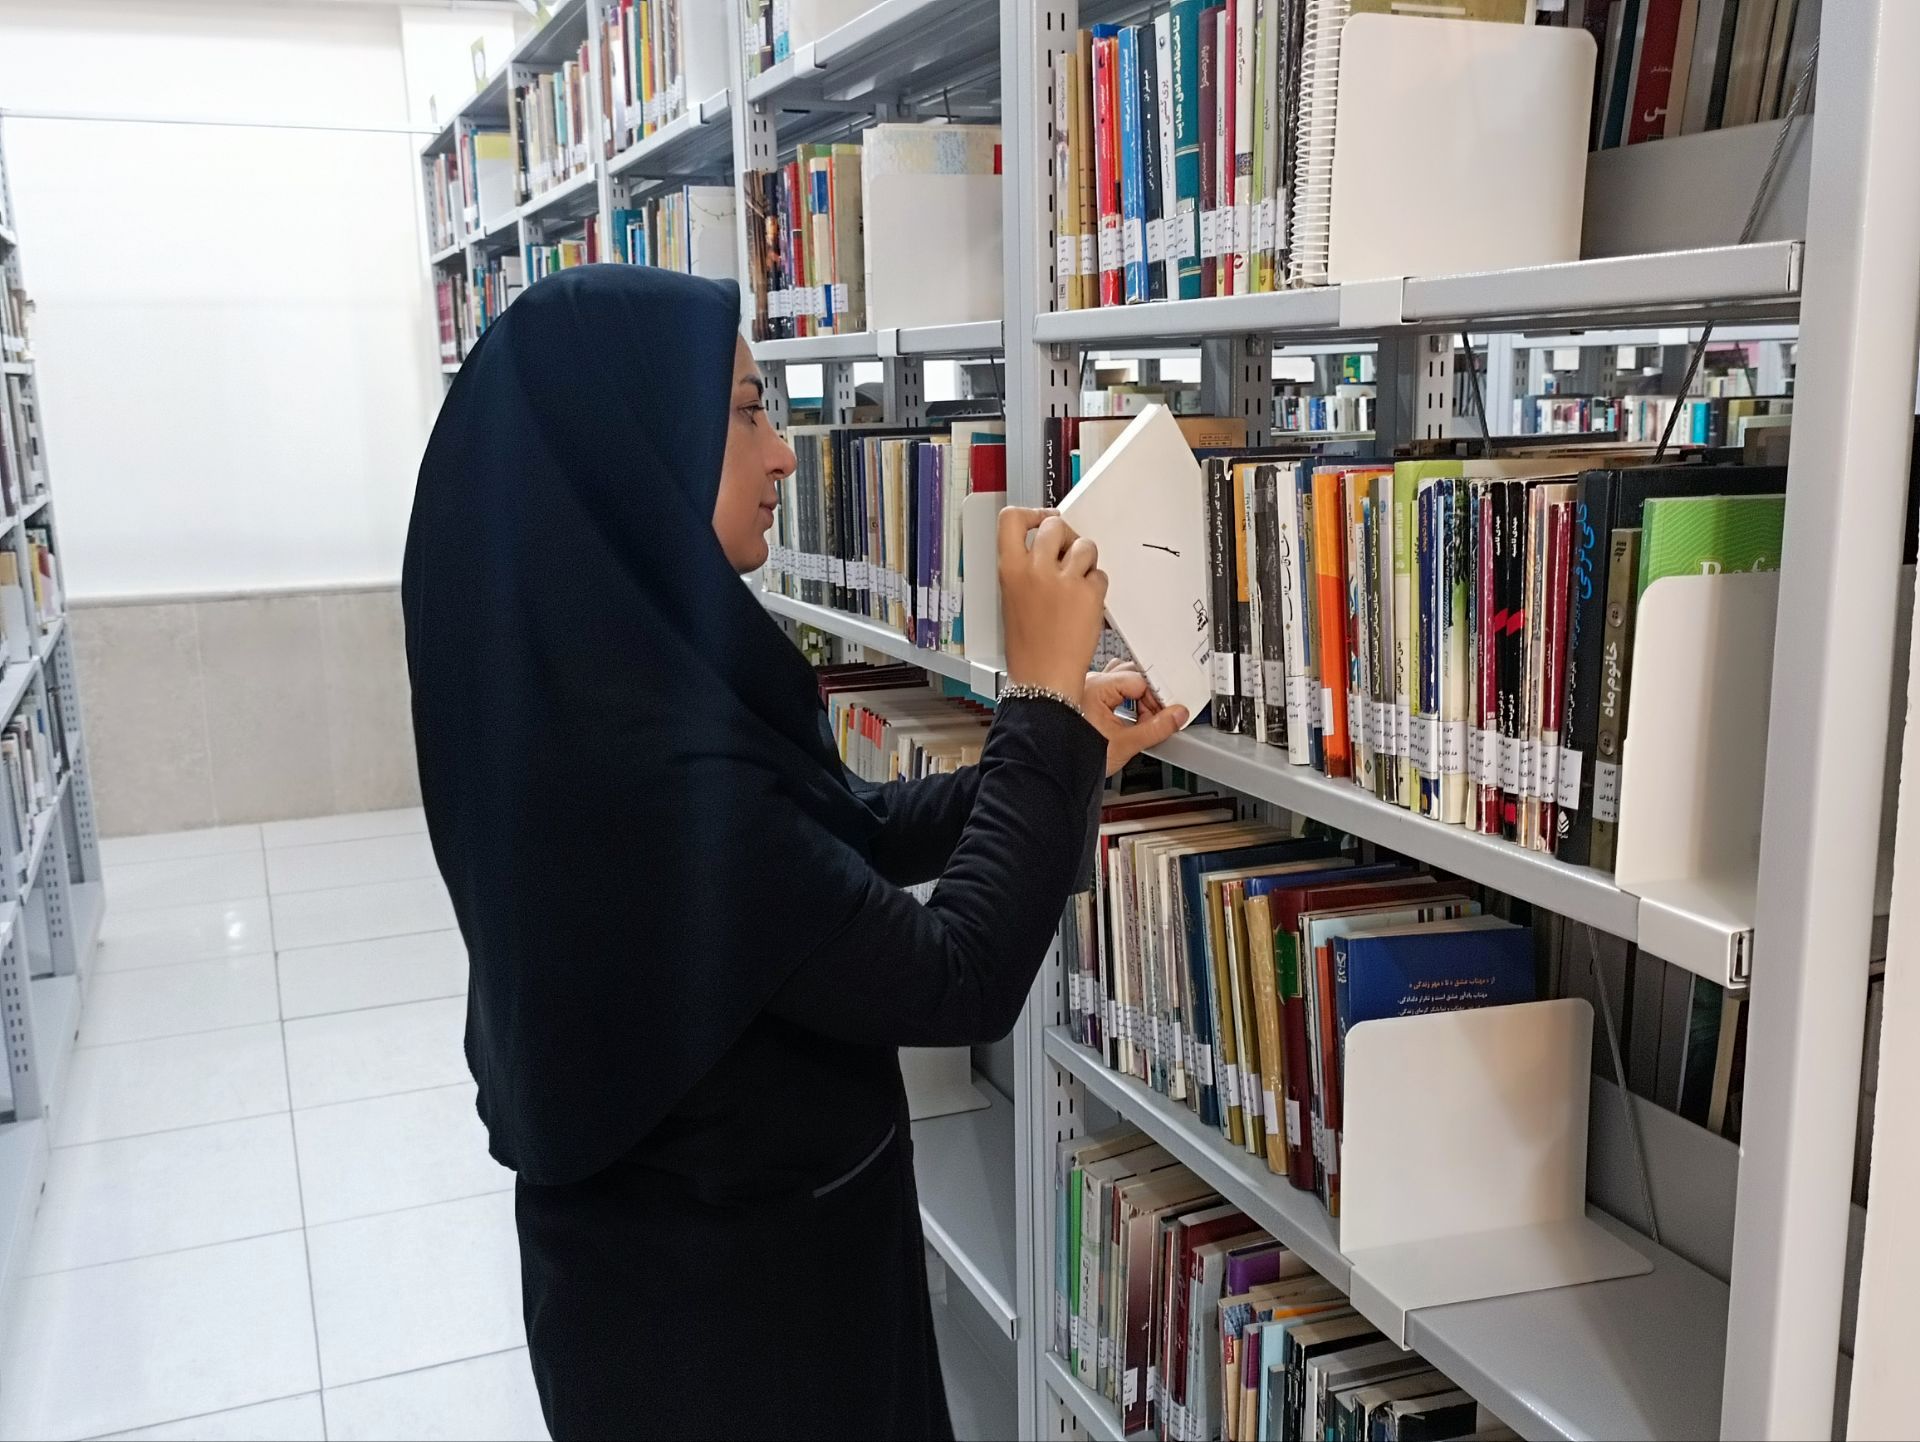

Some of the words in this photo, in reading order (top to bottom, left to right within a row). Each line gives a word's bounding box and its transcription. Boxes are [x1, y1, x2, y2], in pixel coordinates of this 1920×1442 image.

[1175, 73, 1183, 102] صادق
[1175, 103, 1184, 139] هدایت
[1046, 458, 1053, 470] ها
[1214, 499, 1221, 510] که
[1396, 656, 1404, 673] خالی
[1605, 642, 1621, 690] خانوم
[1601, 690, 1615, 718] ماه
